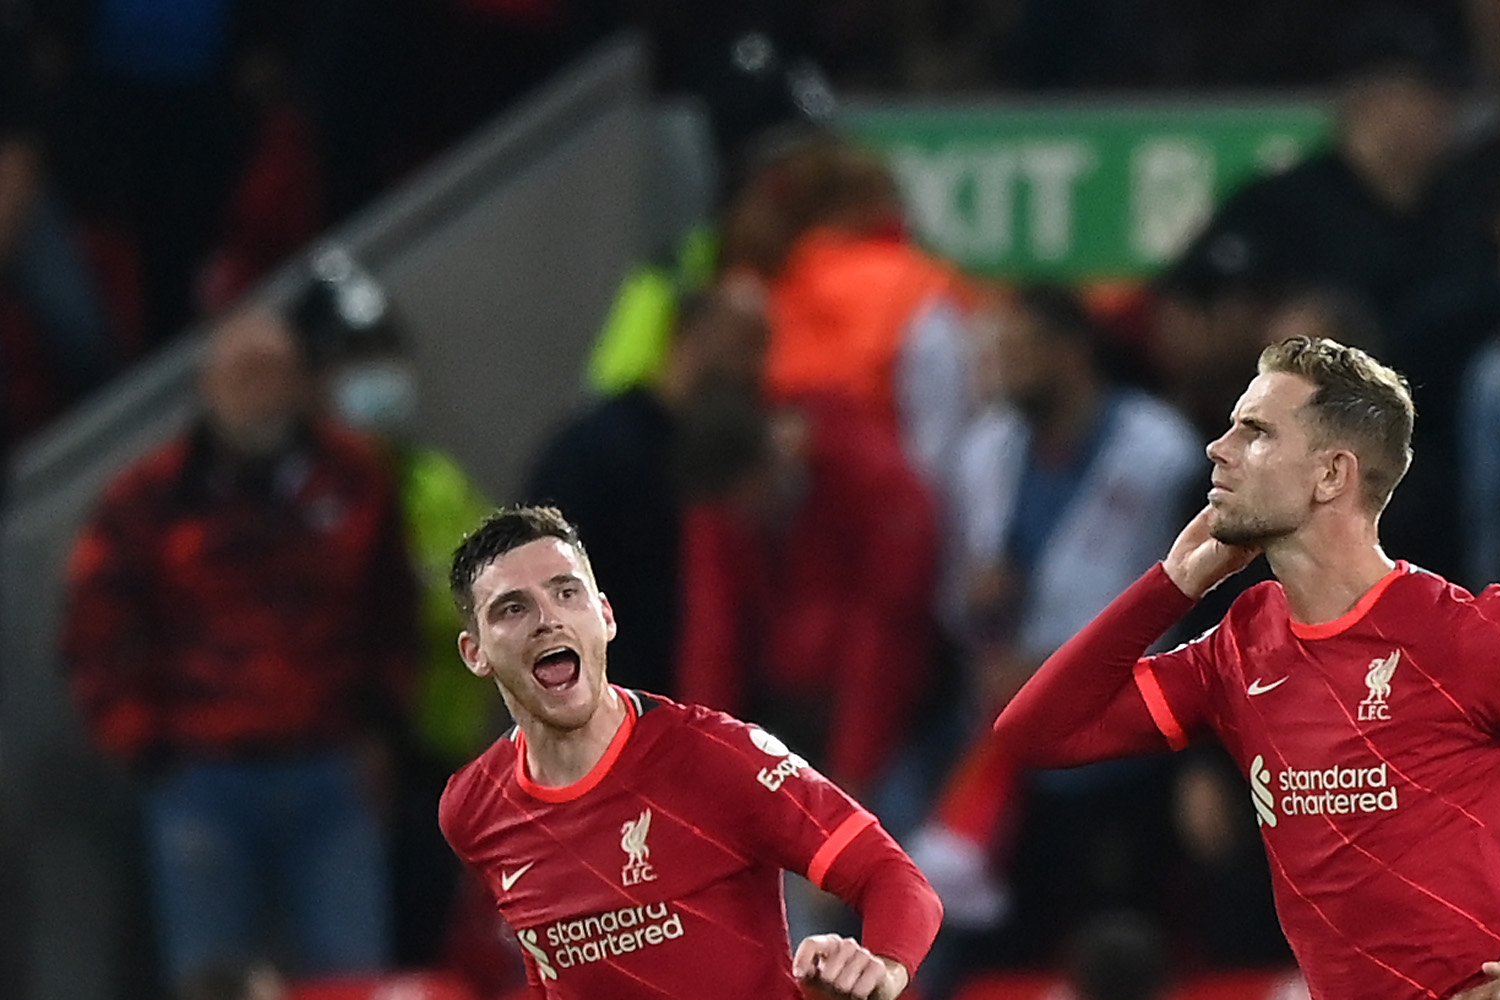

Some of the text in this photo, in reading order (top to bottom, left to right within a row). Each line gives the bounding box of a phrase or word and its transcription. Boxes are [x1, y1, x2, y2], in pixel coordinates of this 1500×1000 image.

[1279, 763, 1387, 791] standard
[1281, 786, 1399, 815] chartered
[555, 913, 685, 968] chartered
